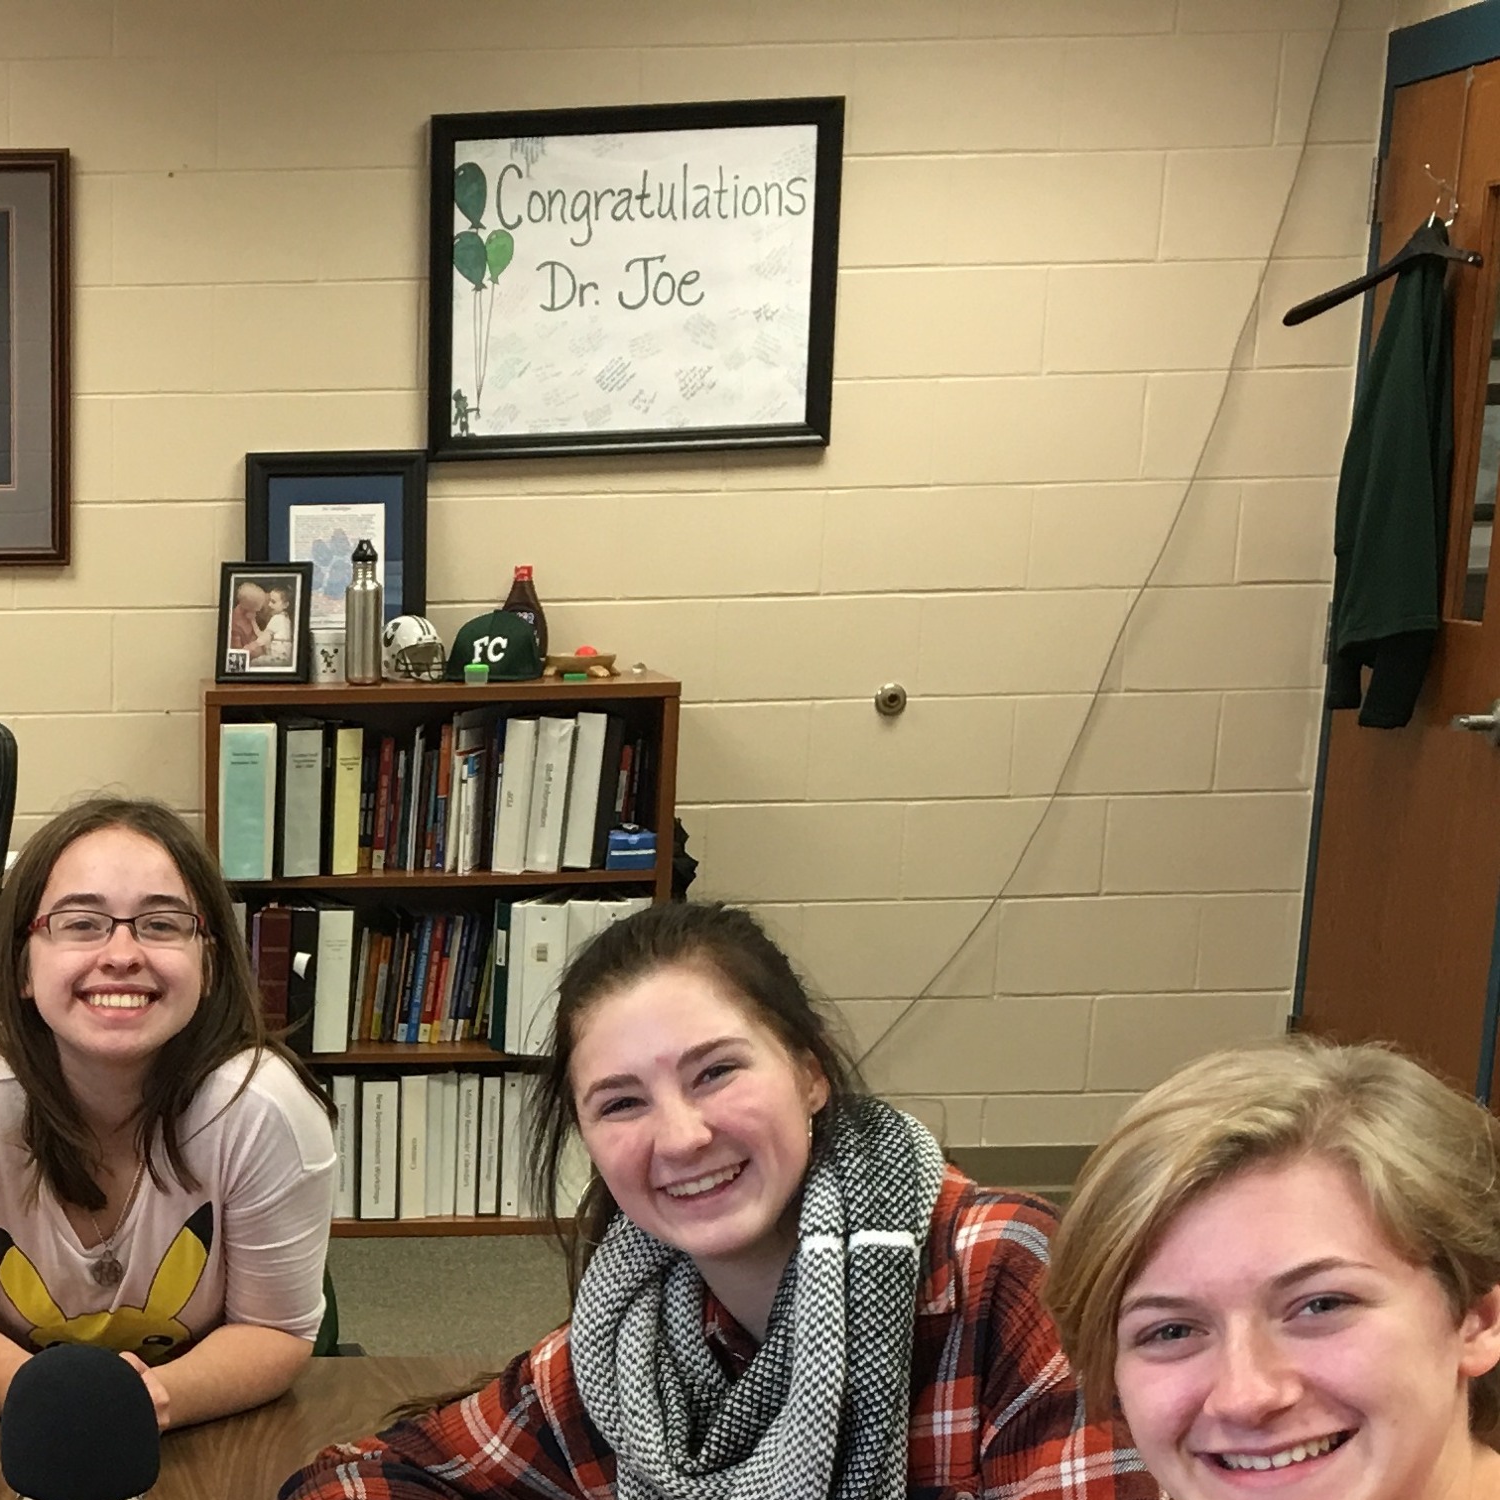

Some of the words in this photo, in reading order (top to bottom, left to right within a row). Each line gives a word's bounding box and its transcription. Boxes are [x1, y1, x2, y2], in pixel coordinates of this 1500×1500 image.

[496, 163, 808, 247] Congratulations
[535, 260, 600, 312] Dr.
[618, 255, 705, 310] Joe
[472, 635, 508, 664] FC
